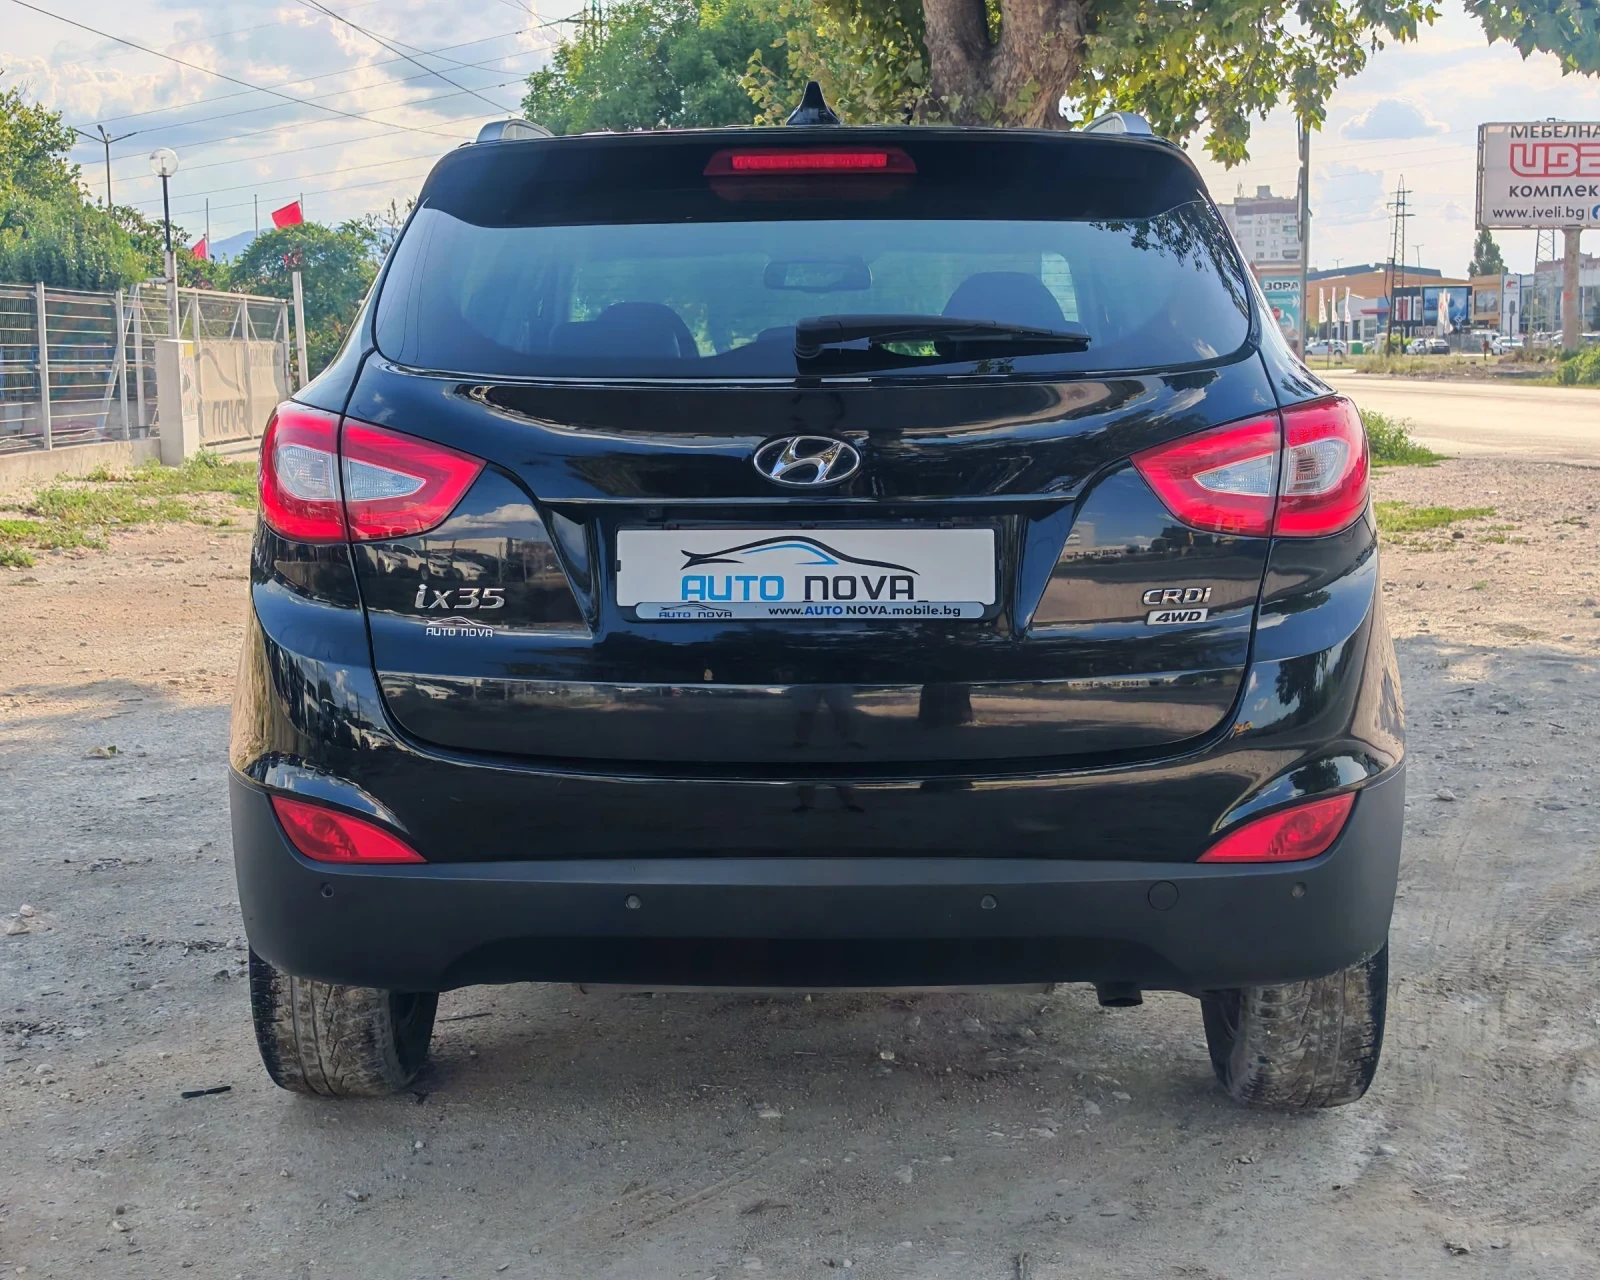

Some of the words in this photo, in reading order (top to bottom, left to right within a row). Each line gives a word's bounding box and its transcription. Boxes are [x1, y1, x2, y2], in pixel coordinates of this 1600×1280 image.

[1492, 206, 1585, 221] www.iveli.bg
[1264, 281, 1299, 291] ЗОРА
[681, 575, 785, 601] AUTO
[804, 575, 914, 601] NOVA
[414, 583, 505, 609] ix35
[768, 605, 843, 615] www.AUTO
[846, 605, 961, 617] NOVA.mobile.bg
[1155, 611, 1202, 622] 4WD
[426, 627, 456, 636] AUTO
[461, 628, 493, 637] NOVA
